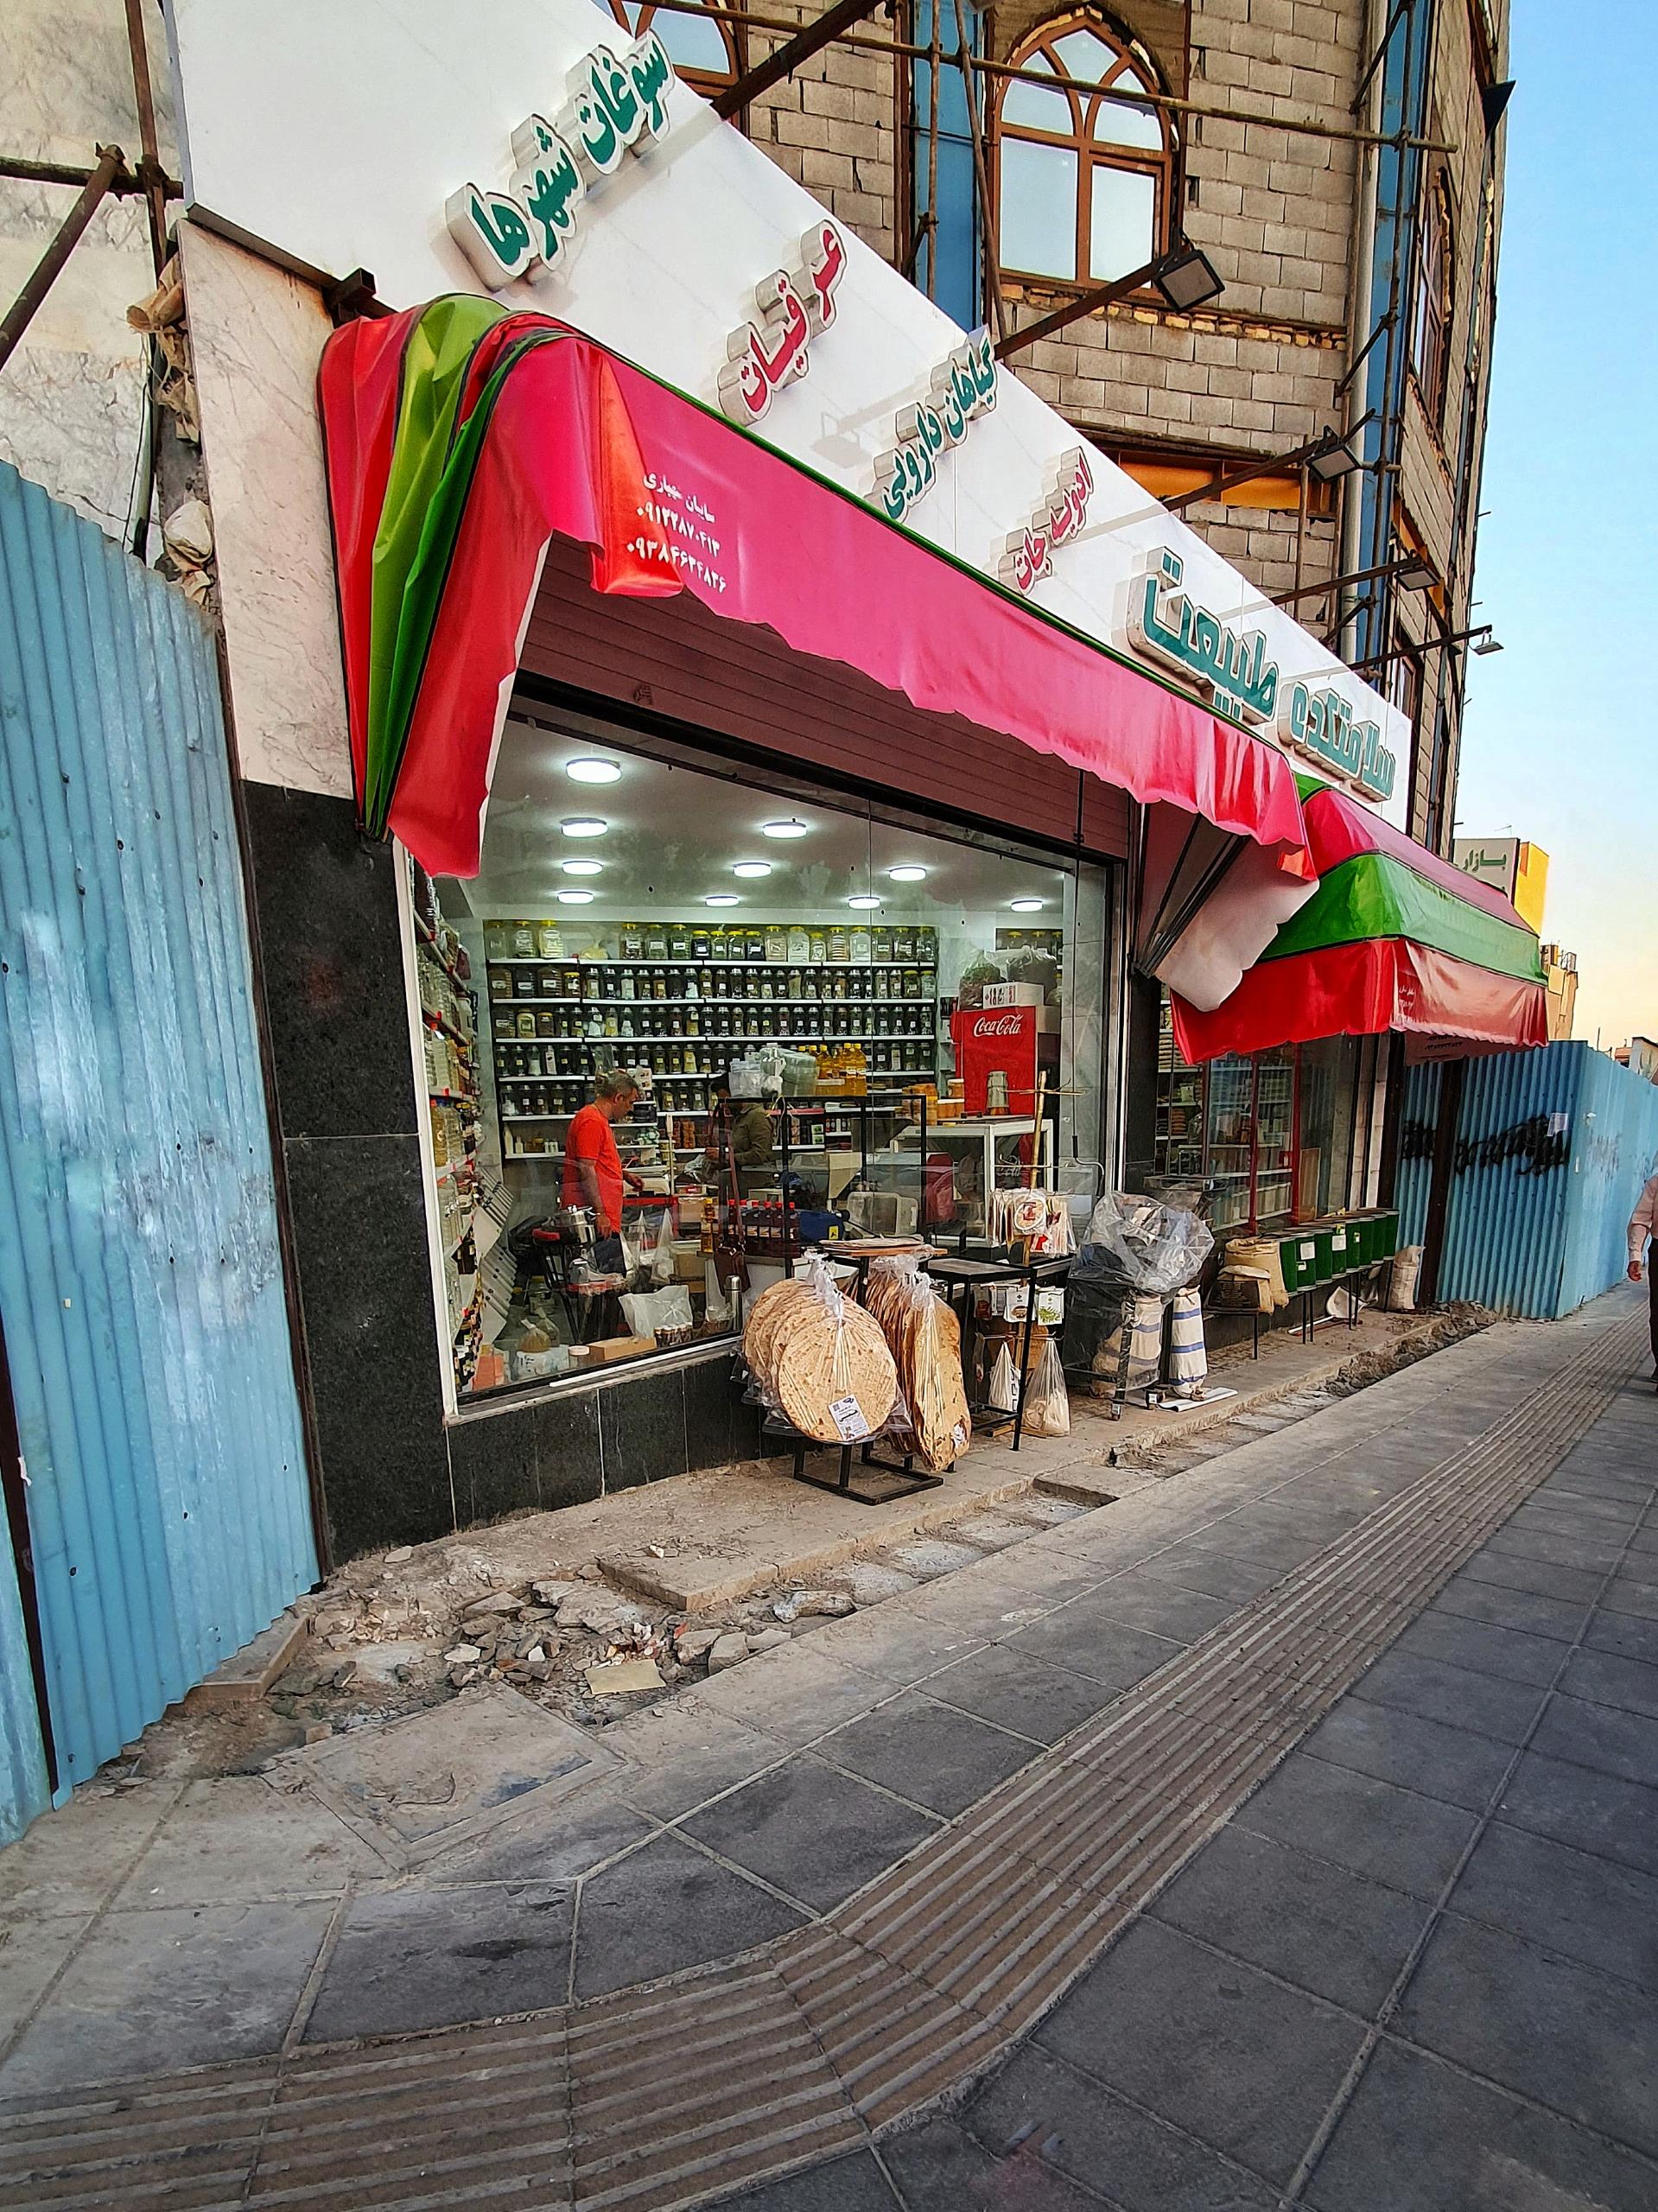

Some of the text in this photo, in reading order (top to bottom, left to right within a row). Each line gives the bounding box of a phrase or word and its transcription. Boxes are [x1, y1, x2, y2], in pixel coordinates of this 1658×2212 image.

[580, 40, 670, 165] سوغات
[741, 228, 842, 413] عرقیات
[883, 337, 995, 519] گیاهان دارویی
[1016, 452, 1091, 590] ادویه جات
[1142, 551, 1276, 720] طبیعت
[1462, 849, 1507, 872] بازار
